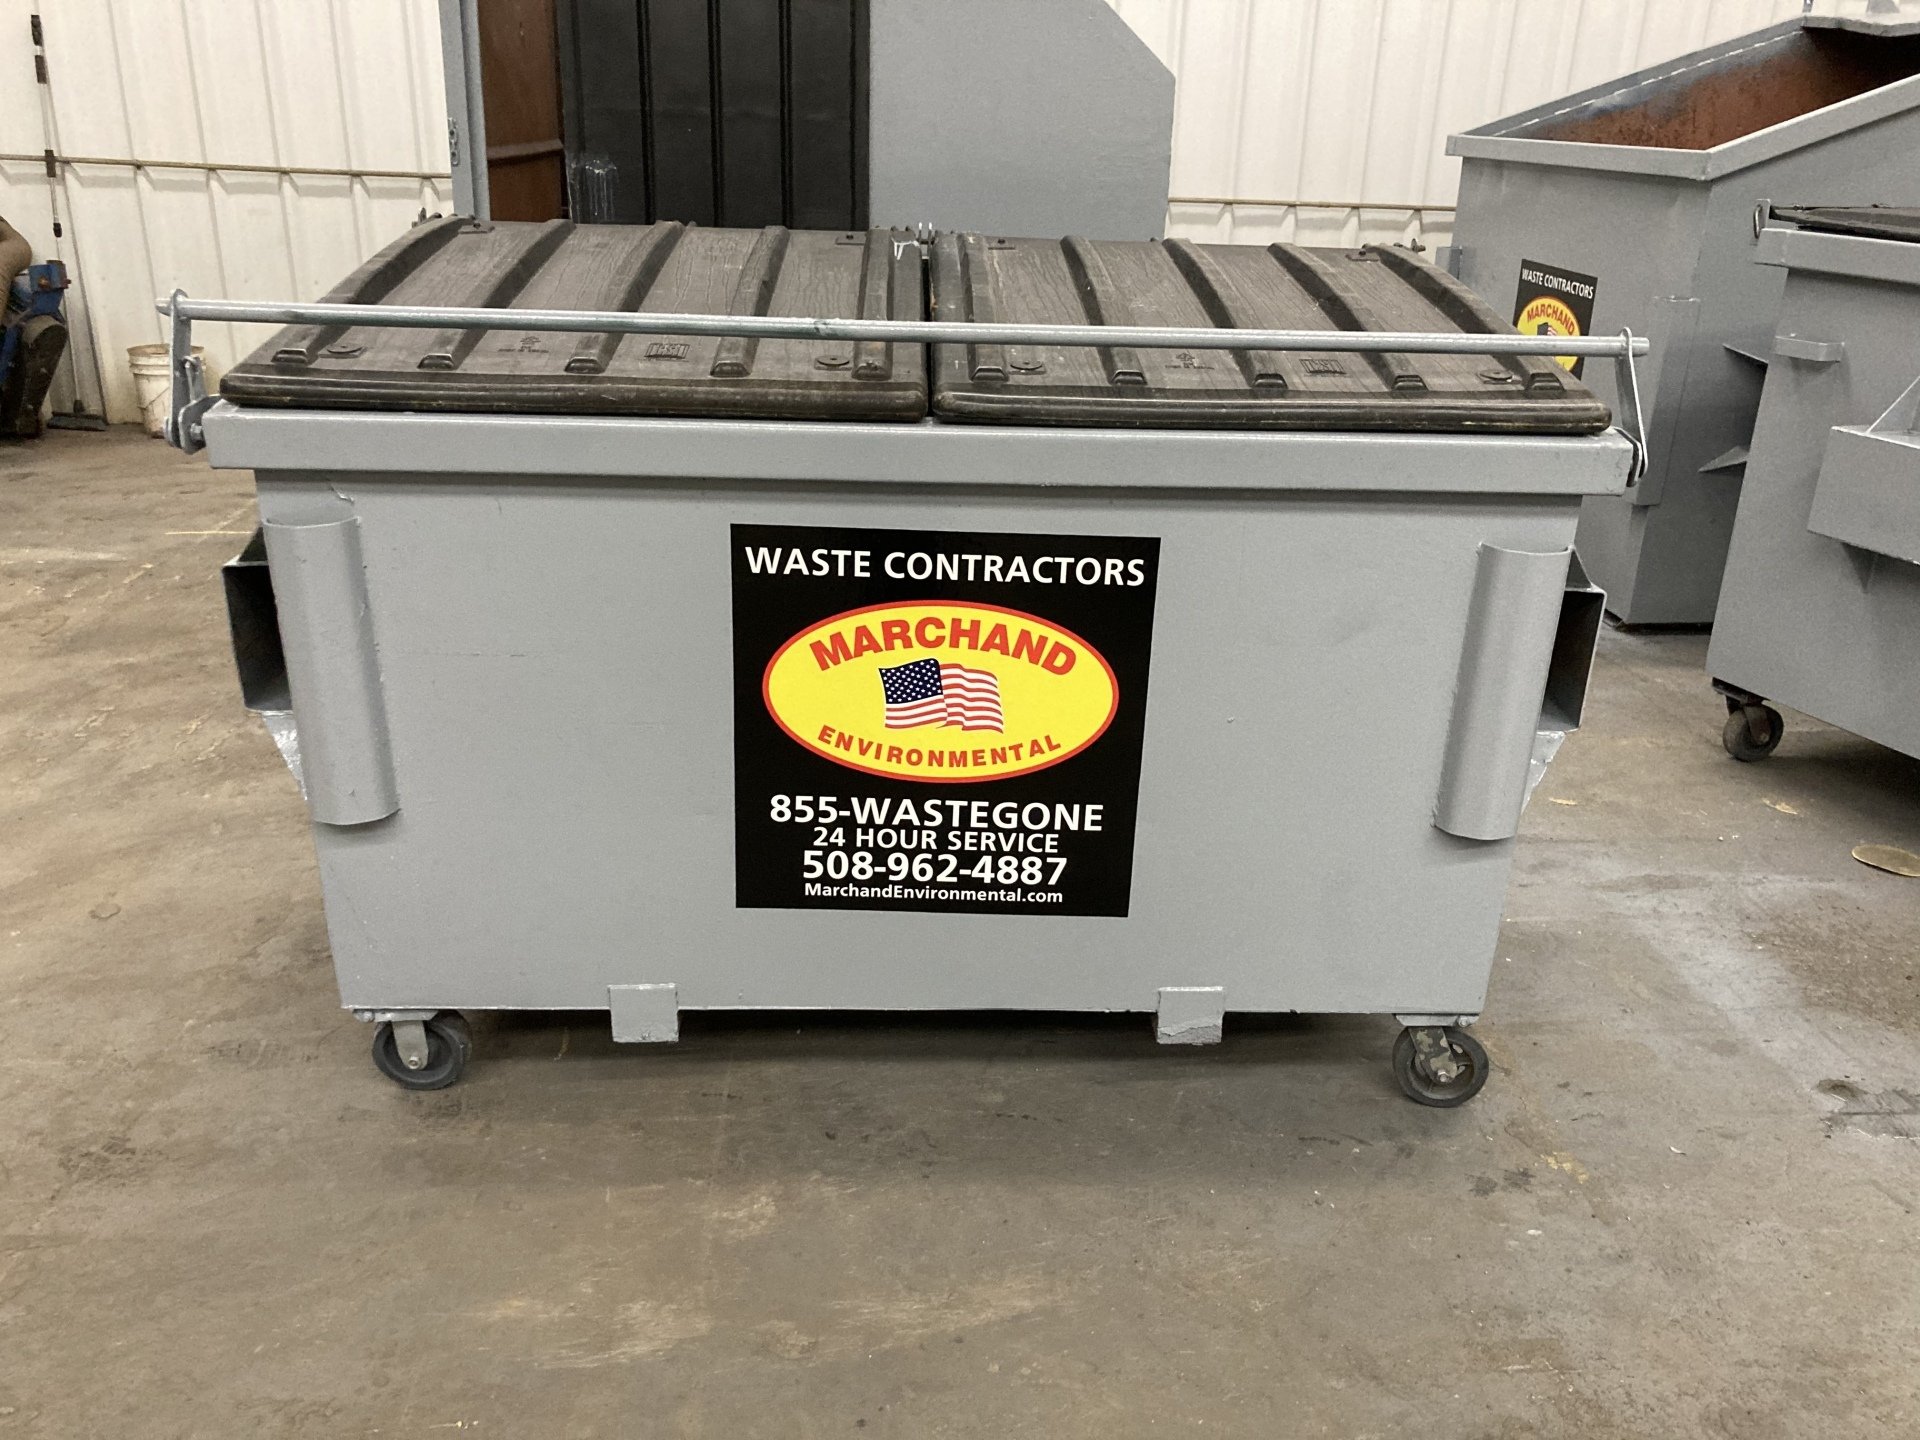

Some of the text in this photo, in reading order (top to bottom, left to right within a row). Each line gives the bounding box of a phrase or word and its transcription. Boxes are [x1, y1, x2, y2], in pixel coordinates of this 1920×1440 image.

[1522, 268, 1594, 299] WASTE CONTRACTORS
[1527, 303, 1575, 336] MARCHAND
[745, 546, 1145, 587] WASTE CONTRACTORS
[809, 616, 1077, 676] MARCHAND
[817, 724, 1062, 768] ENVIRONMENTAL
[770, 794, 1104, 832] 855-WASTEGONE
[813, 827, 1059, 854] 24 HOUR SERVICE
[803, 849, 1068, 886] 508-962-4887
[804, 882, 1063, 903] MarchandEnvironmental.com
